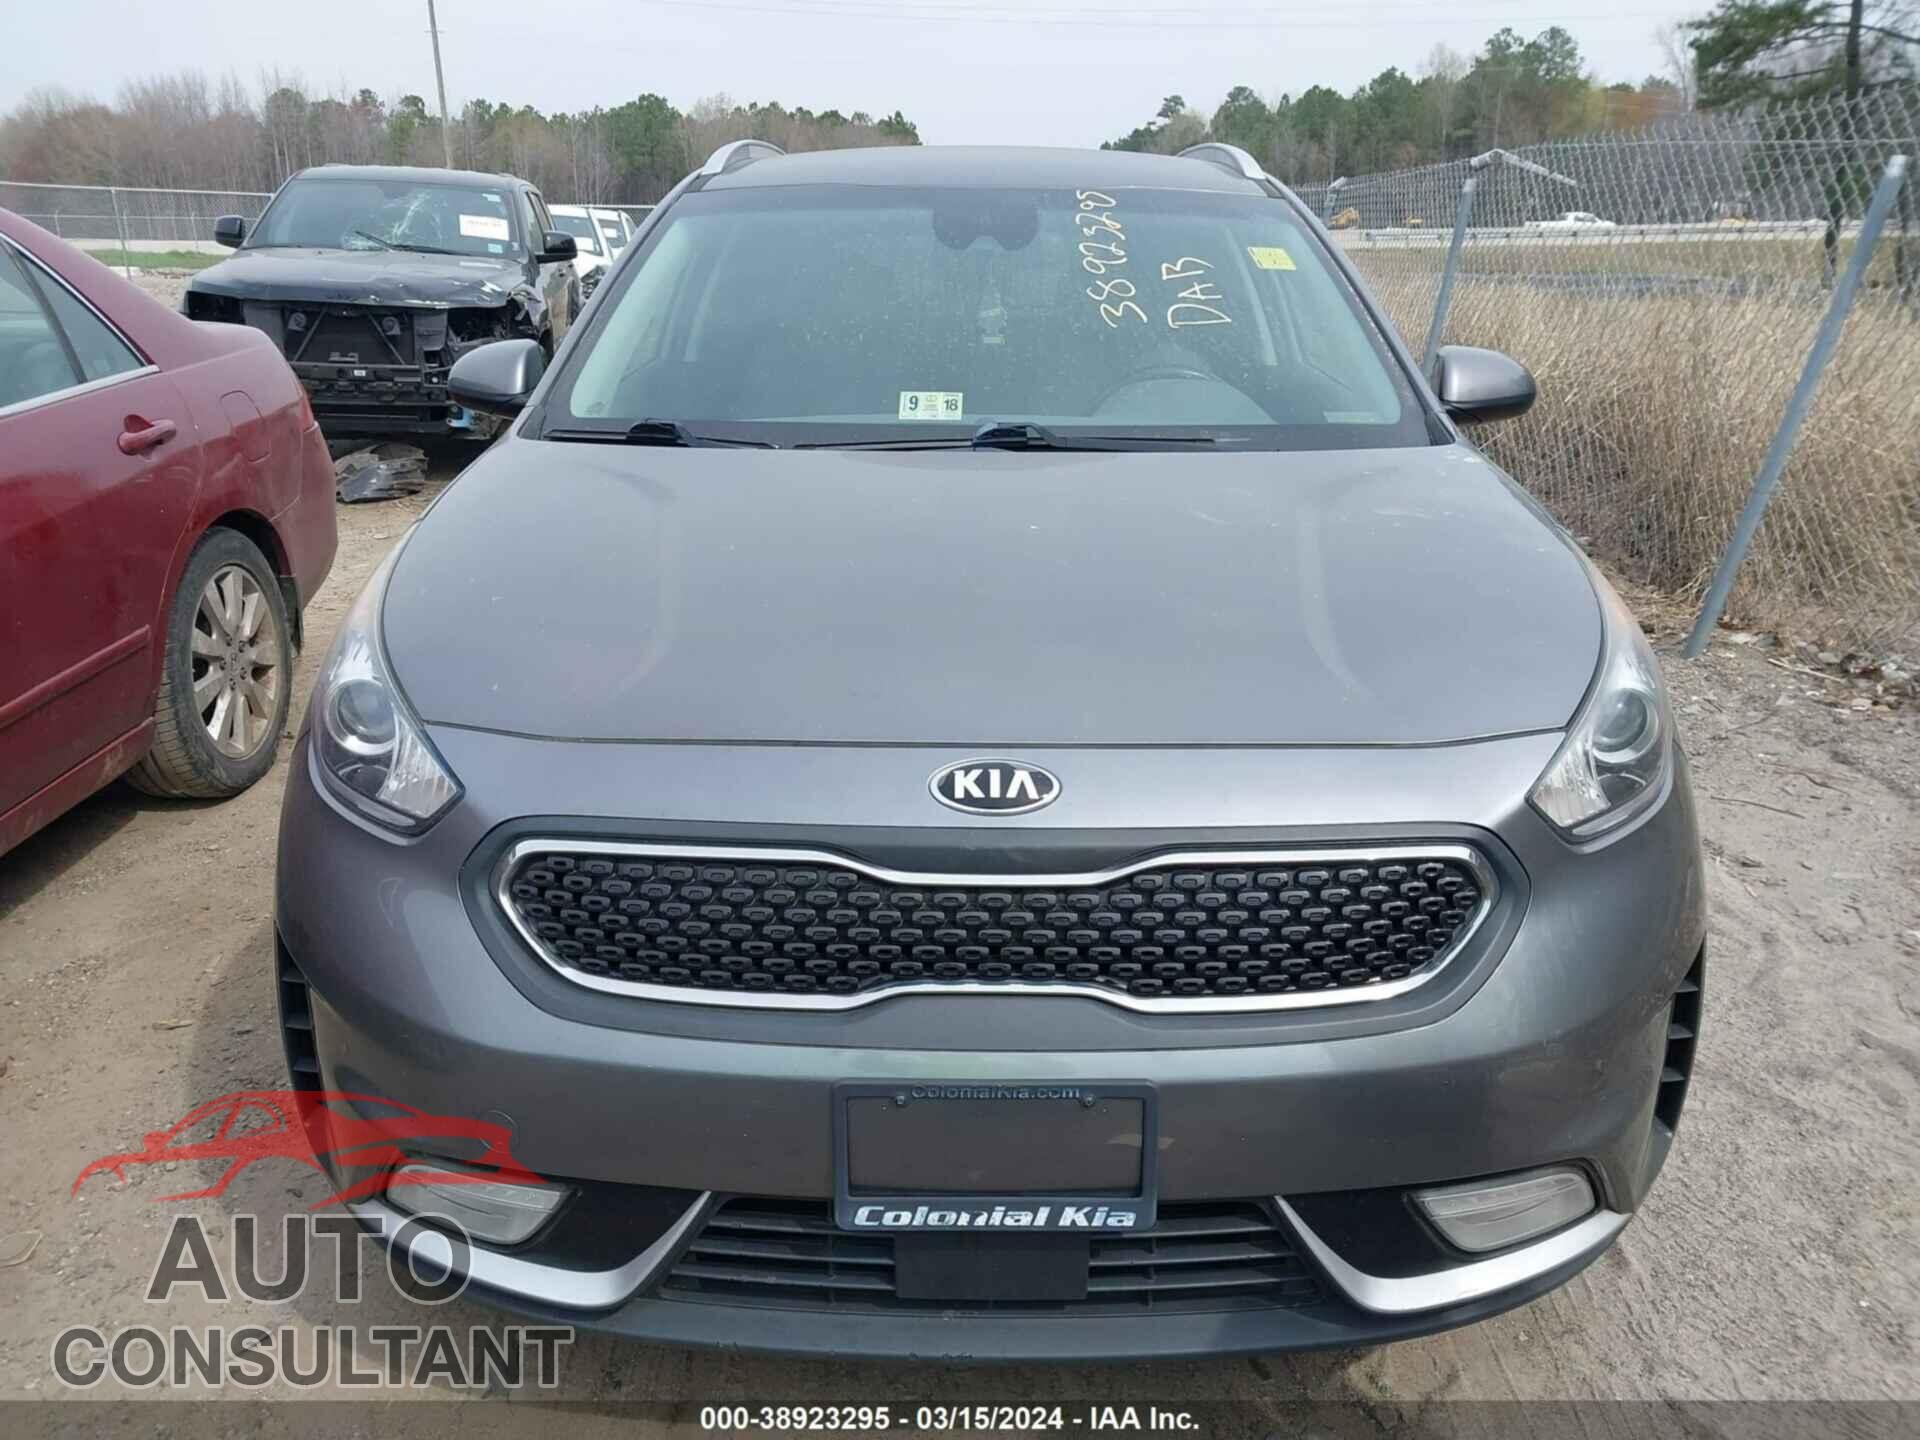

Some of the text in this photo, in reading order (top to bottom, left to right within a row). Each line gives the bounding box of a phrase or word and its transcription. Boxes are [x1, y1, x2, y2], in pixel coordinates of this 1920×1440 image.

[1161, 257, 1232, 328] DAB
[908, 395, 919, 411] 9
[944, 398, 959, 411] 18
[952, 768, 1041, 800] KIA
[854, 1206, 1137, 1227] Colonial Kia
